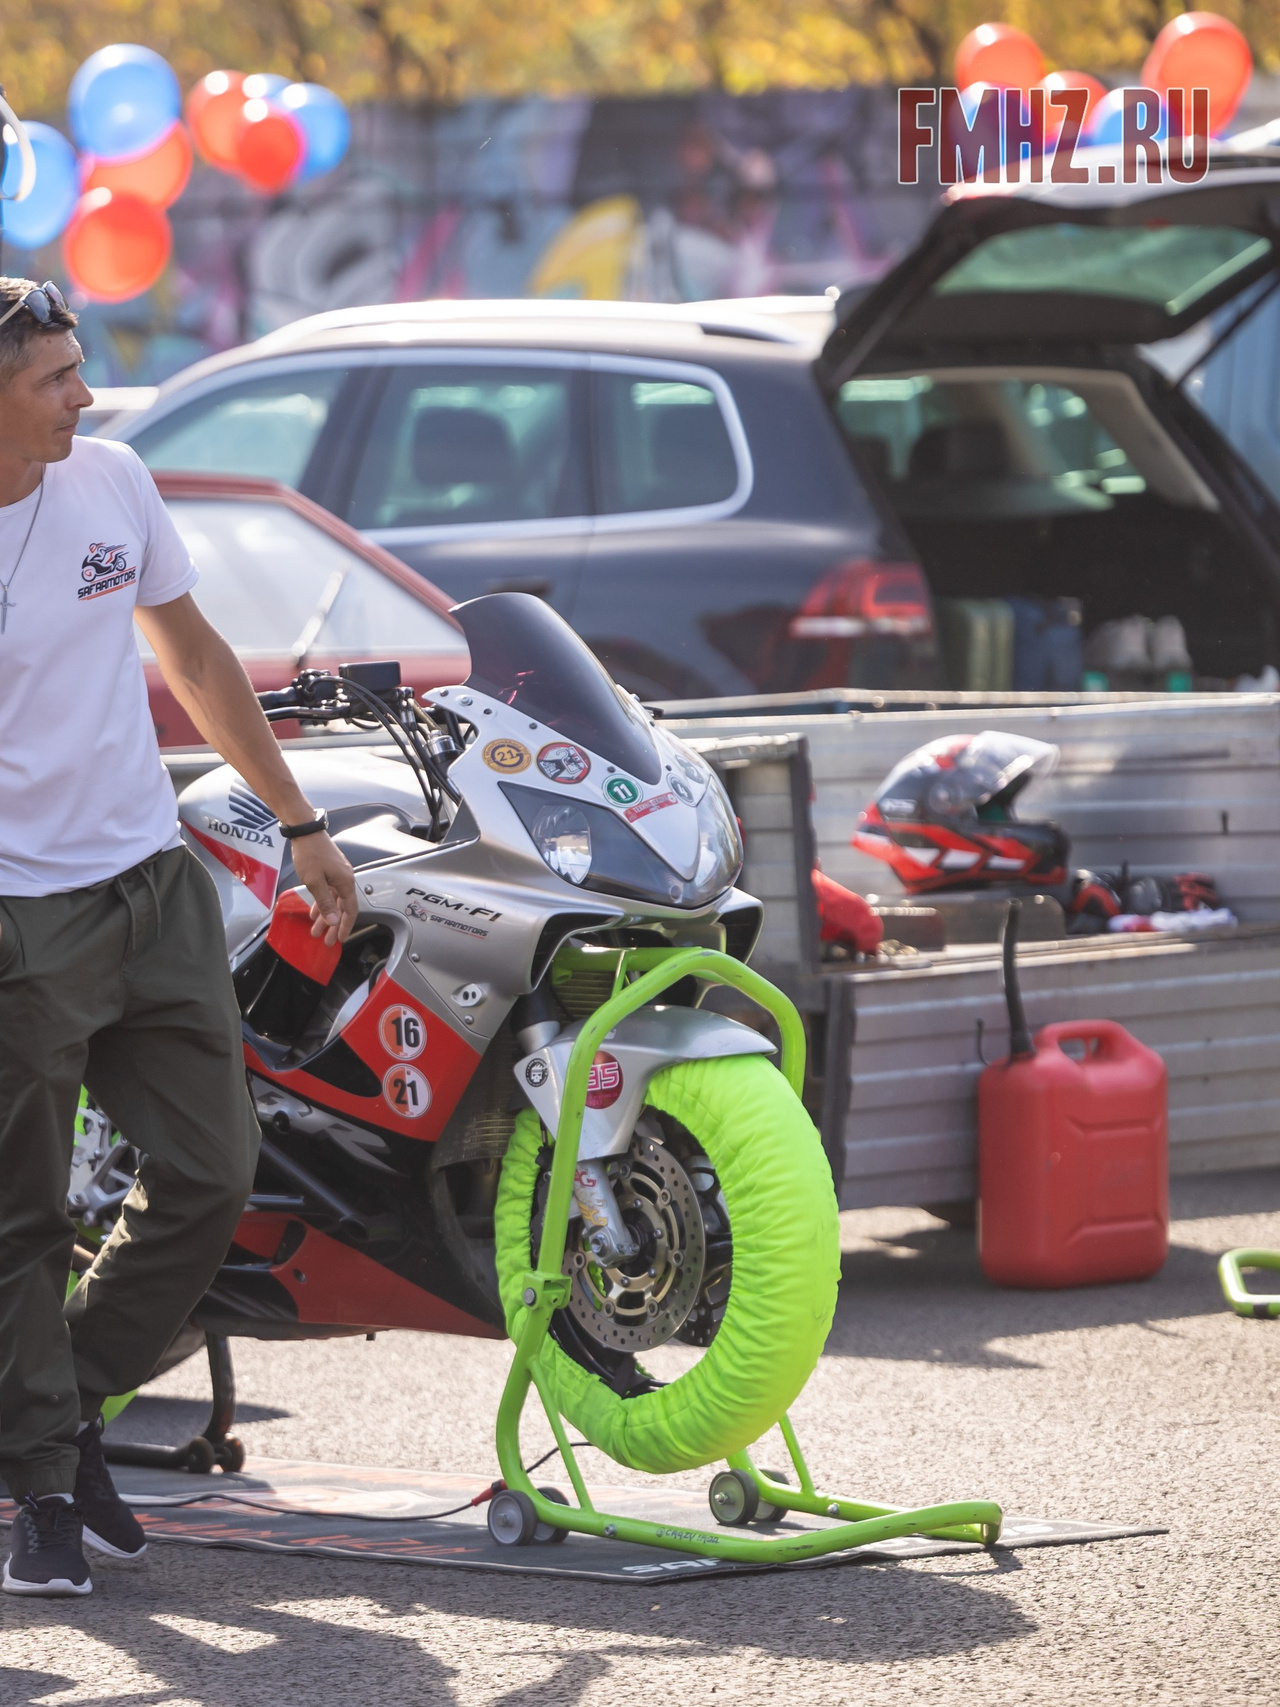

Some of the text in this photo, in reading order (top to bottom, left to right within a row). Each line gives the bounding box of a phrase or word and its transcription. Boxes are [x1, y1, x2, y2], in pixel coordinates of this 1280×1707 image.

[497, 748, 518, 762] 21
[613, 783, 633, 800] 11
[207, 818, 275, 849] HONDA
[405, 887, 503, 922] PGM-FI
[391, 1016, 421, 1048] 16
[393, 1078, 419, 1106] 21
